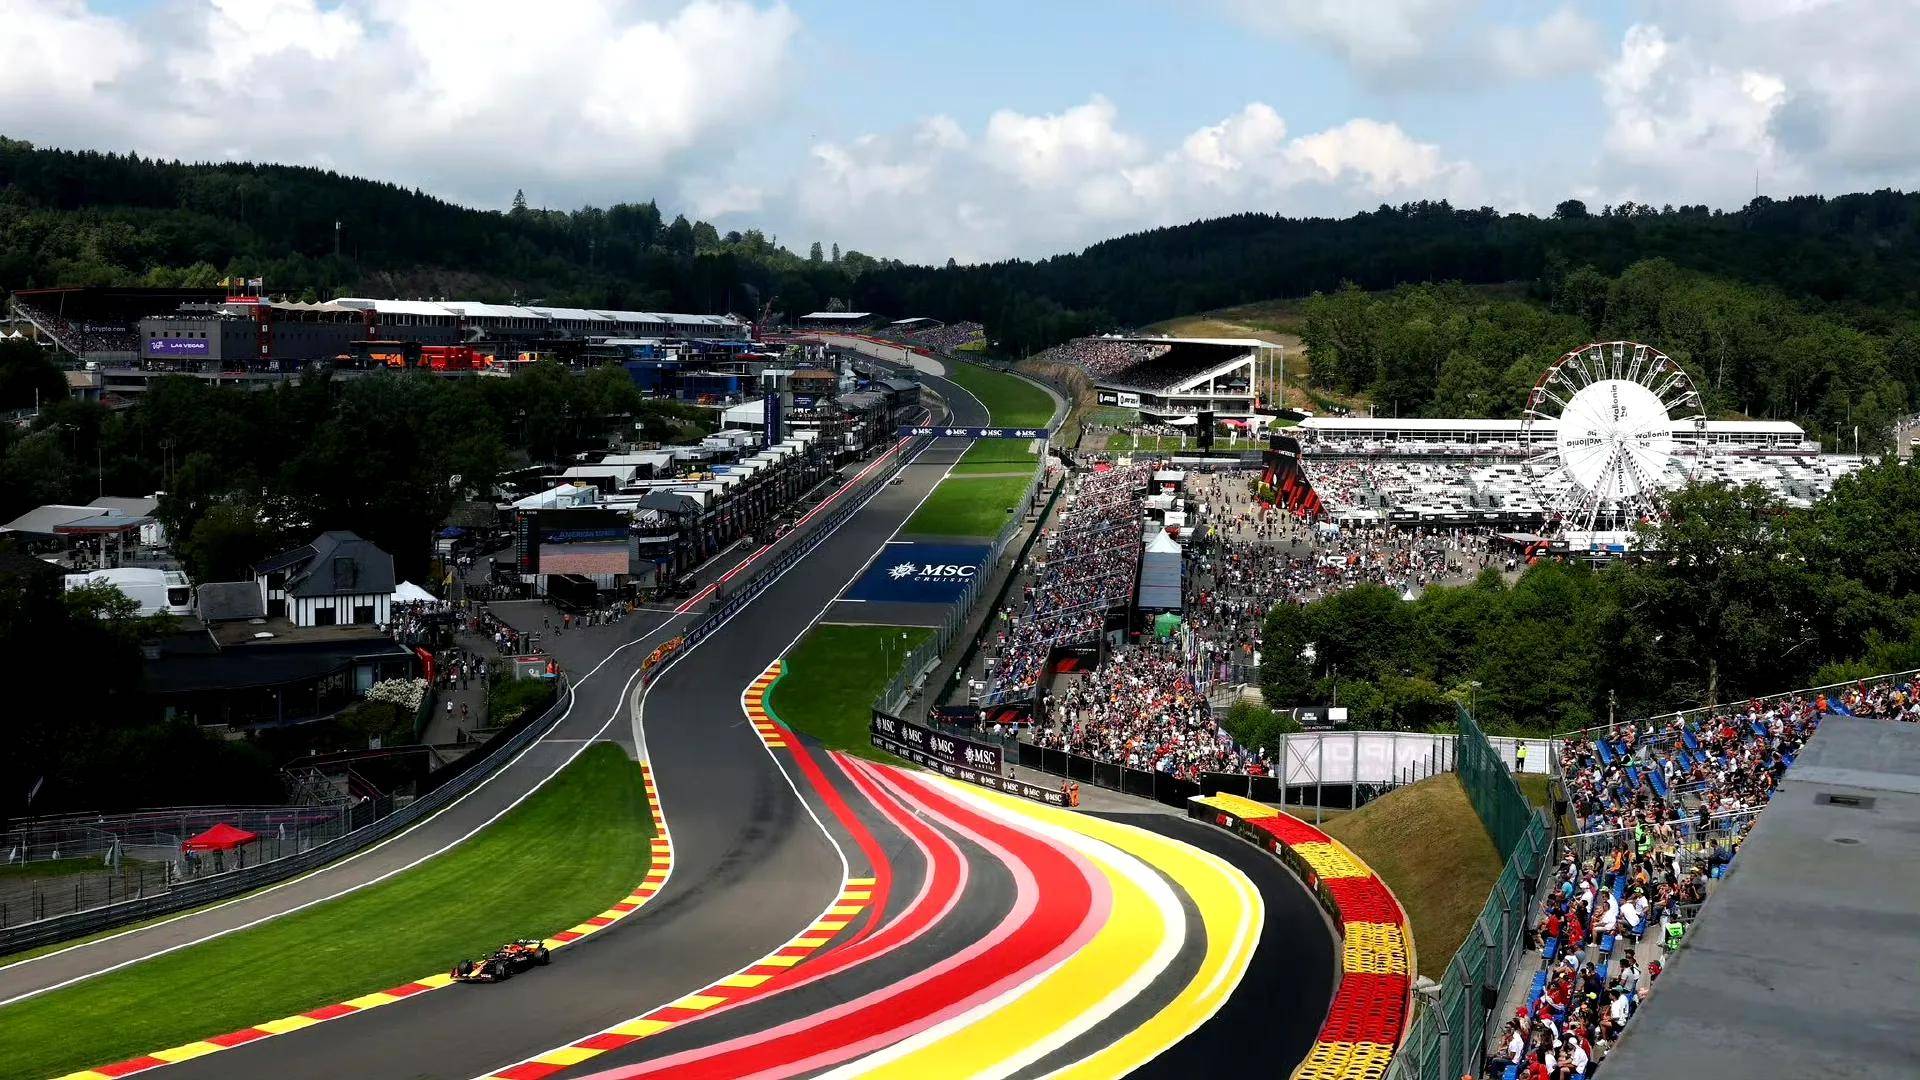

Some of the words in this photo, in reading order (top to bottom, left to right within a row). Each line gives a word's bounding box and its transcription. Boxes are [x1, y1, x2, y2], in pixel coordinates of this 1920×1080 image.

[919, 565, 976, 576] MSC
[882, 718, 895, 733] MSC
[908, 728, 922, 743] MSC
[938, 738, 954, 754] MSC
[975, 749, 995, 764] MSC
[965, 772, 975, 780] MSC
[986, 777, 996, 785] MSC
[1007, 783, 1018, 791] MSC
[1029, 788, 1040, 797] MSC
[1050, 794, 1062, 802] MSC
